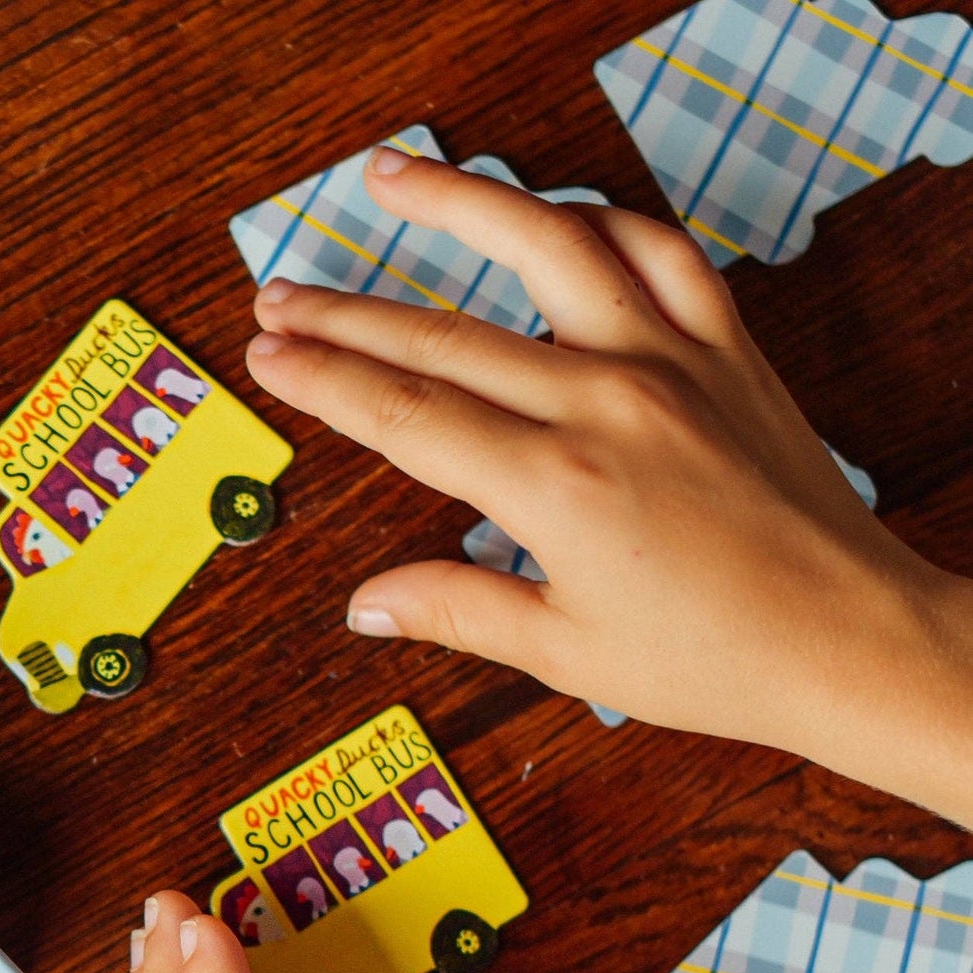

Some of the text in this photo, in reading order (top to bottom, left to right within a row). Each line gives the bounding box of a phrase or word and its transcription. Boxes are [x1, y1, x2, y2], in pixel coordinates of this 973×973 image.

[3, 319, 157, 492] SCHOOL BUS
[64, 314, 125, 383] Ducks
[244, 720, 405, 829] QUACKY Ducks
[245, 731, 432, 864] SCHOOL BUS
